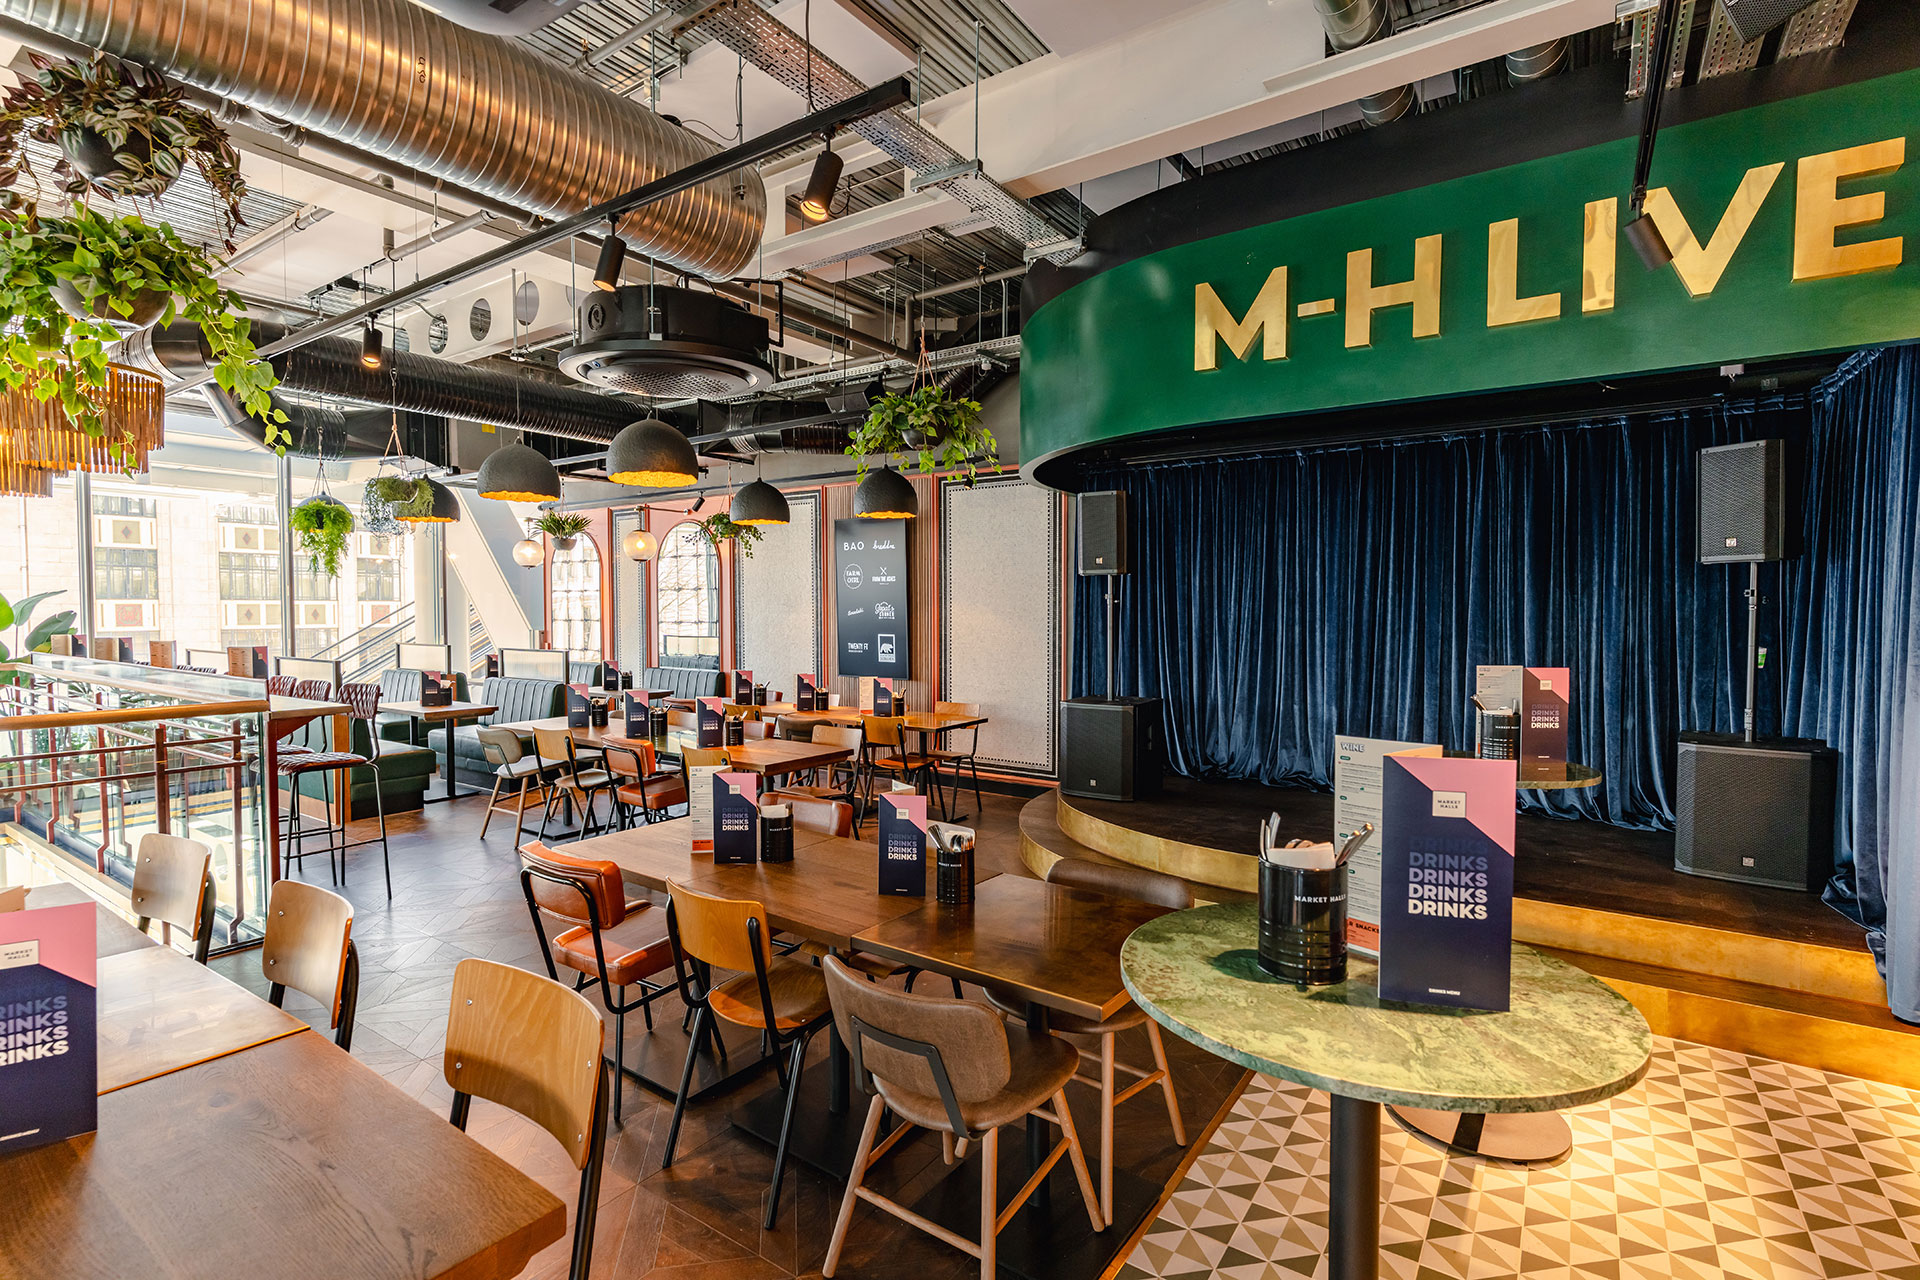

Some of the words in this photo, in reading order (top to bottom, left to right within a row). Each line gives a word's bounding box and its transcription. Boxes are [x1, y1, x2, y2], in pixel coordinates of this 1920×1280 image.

[1194, 233, 1443, 372] M-H
[1486, 136, 1906, 327] LIVE
[844, 541, 864, 551] BAO
[1341, 742, 1364, 753] WINE
[888, 839, 917, 847] DRINKS
[888, 846, 917, 854] DRINKS
[888, 852, 917, 860] DRINKS
[1409, 851, 1488, 871] DRINKS
[1409, 867, 1488, 887] DRINKS
[1294, 895, 1328, 904] MARKET
[1408, 883, 1488, 904] DRINKS
[1408, 899, 1488, 920] DRINKS
[0, 995, 68, 1019] INKS
[0, 1010, 69, 1035] INKS
[0, 1025, 69, 1051] INKS
[0, 1040, 70, 1067] INKS
